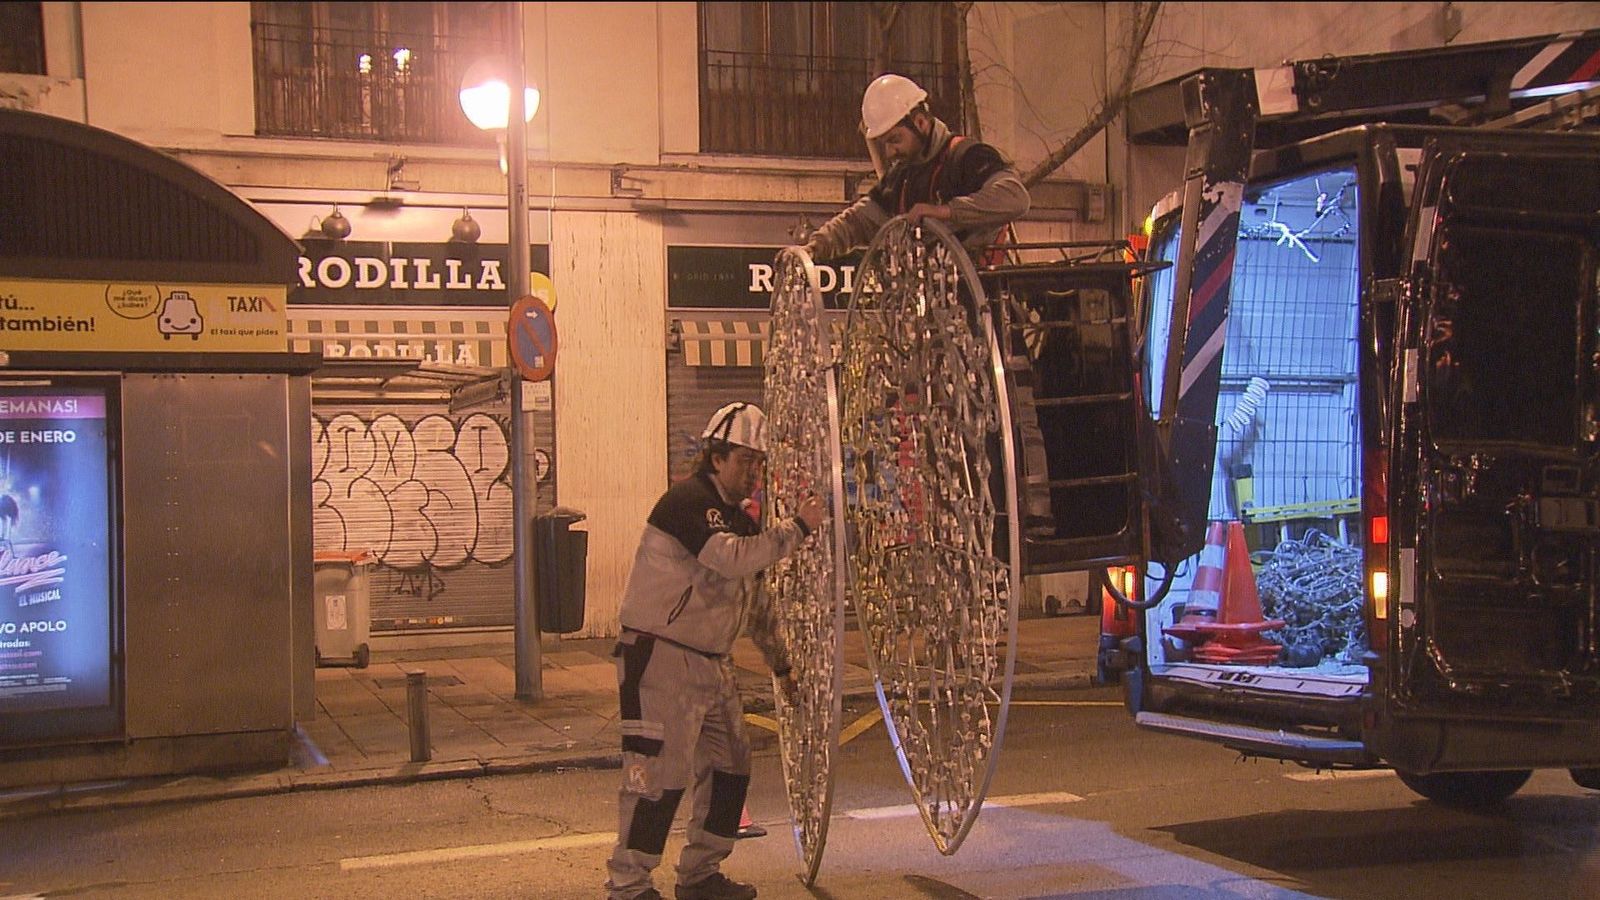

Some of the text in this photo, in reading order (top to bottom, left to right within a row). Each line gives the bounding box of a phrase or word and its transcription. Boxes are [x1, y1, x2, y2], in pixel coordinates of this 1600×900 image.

[297, 256, 506, 290] RODILLA
[0, 315, 95, 332] también!
[256, 328, 279, 337] pides
[20, 430, 76, 443] ENERO
[20, 620, 67, 634] APOLO
